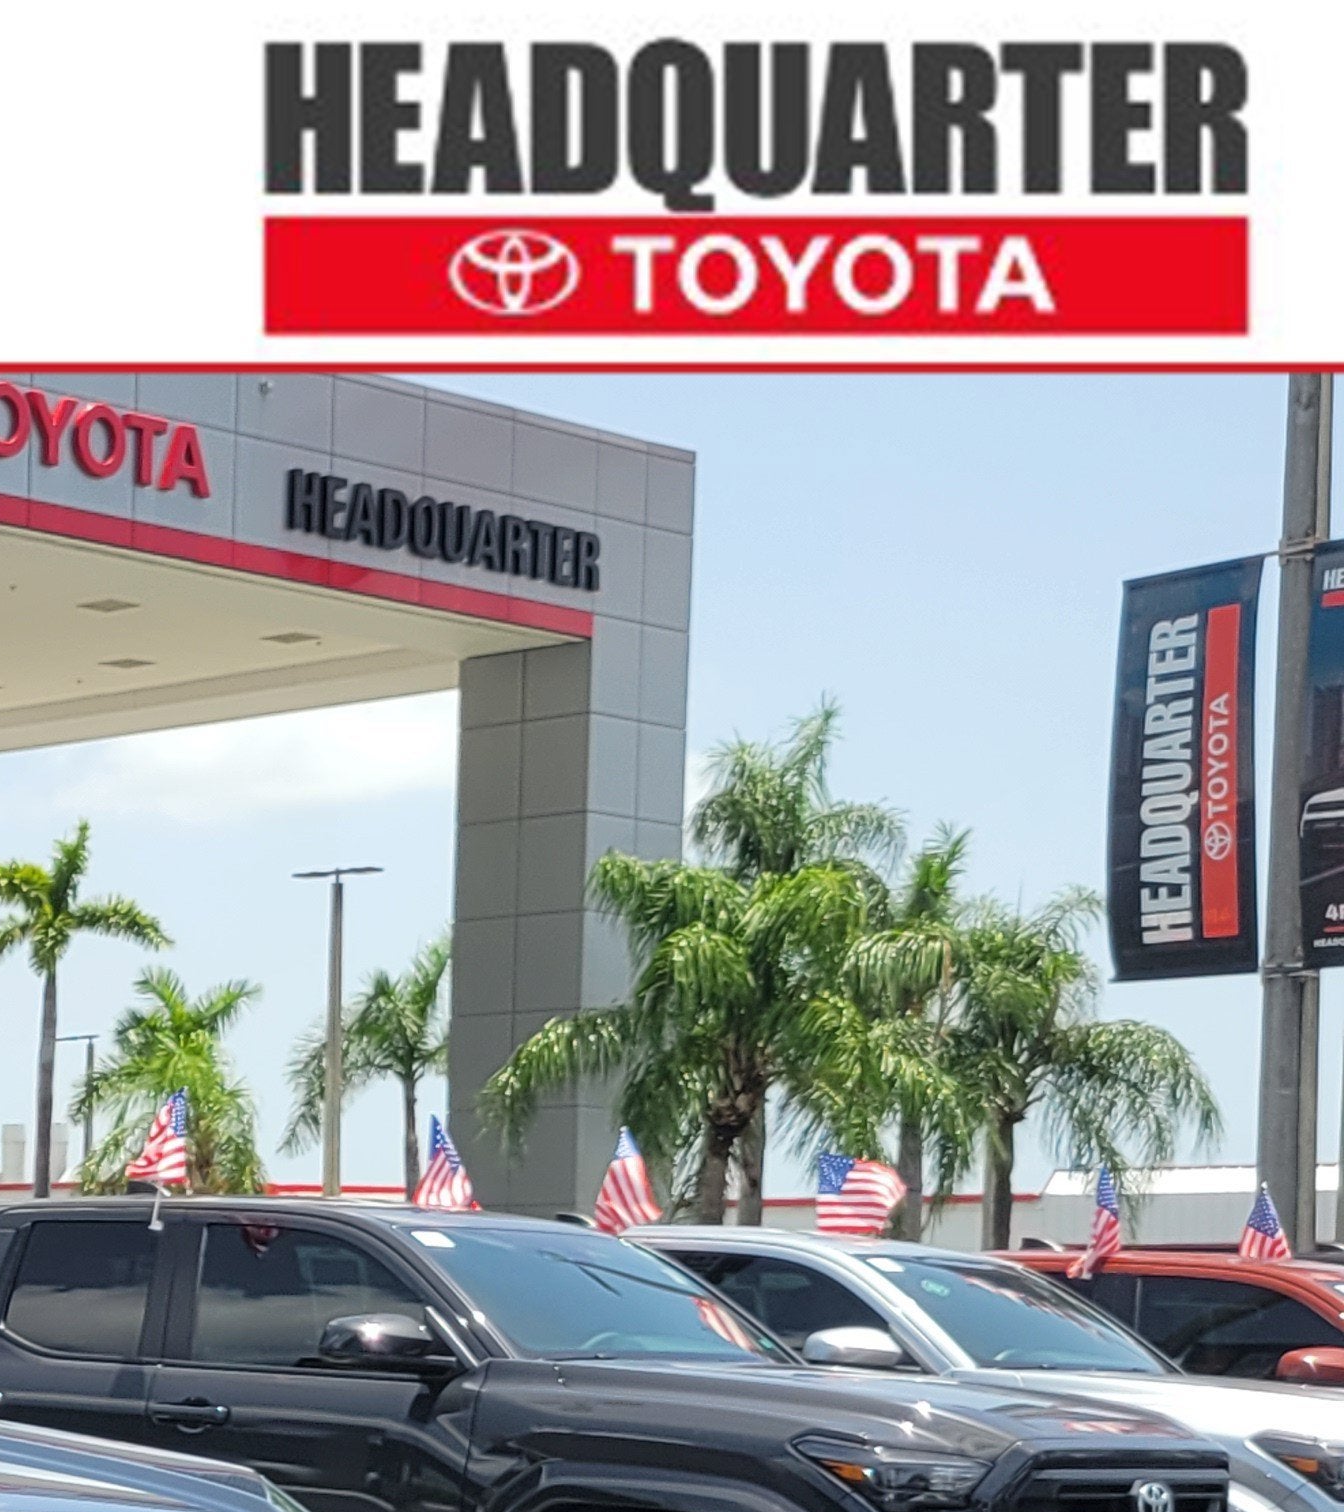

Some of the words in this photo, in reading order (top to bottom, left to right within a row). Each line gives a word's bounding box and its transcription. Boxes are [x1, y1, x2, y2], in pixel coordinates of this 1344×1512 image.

[285, 468, 601, 592] HEADQUARTER
[1139, 613, 1200, 944] HEADQUARTER
[1207, 692, 1231, 818] TOYOTA
